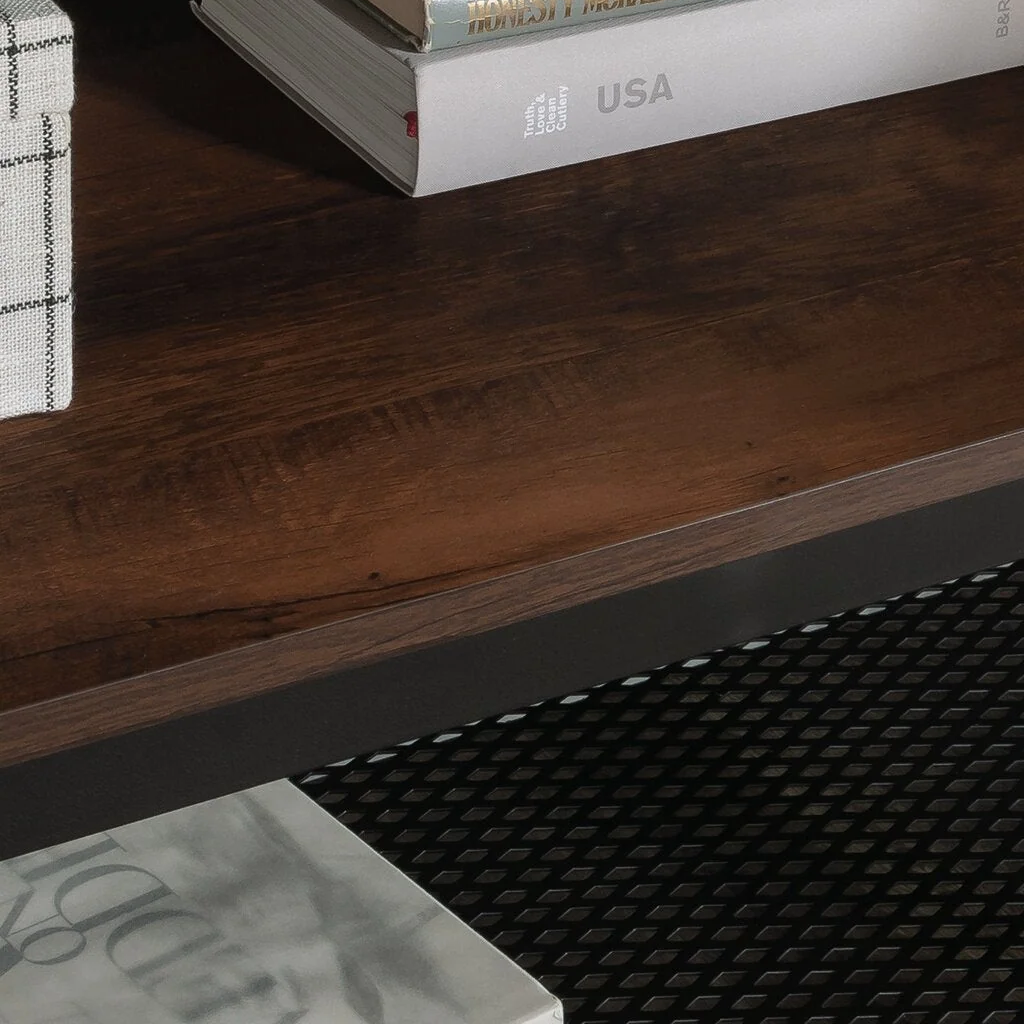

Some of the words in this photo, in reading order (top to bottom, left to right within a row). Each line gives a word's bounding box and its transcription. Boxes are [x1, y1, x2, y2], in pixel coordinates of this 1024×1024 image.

[535, 93, 546, 103] &
[556, 85, 569, 131] Cutlery
[597, 73, 673, 114] USA
[524, 100, 537, 139] Truth,
[535, 106, 545, 136] Love
[545, 97, 557, 133] Clean
